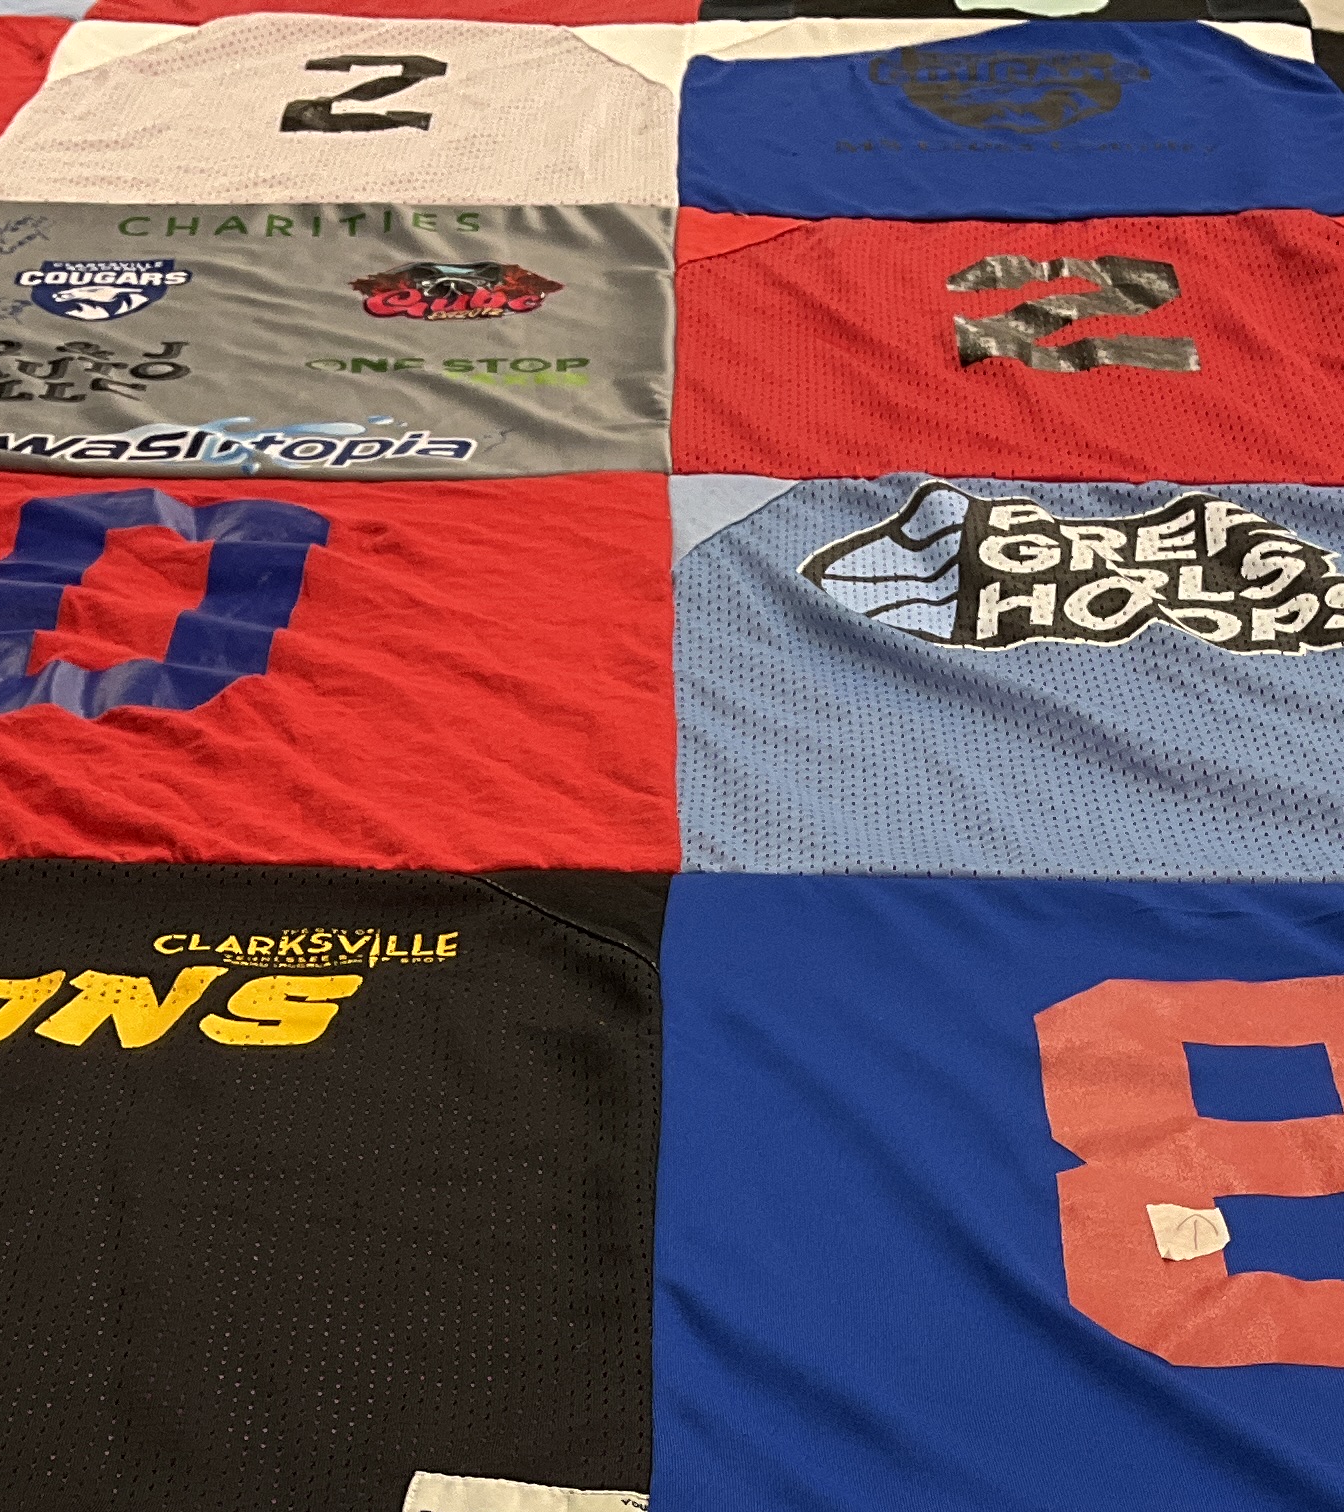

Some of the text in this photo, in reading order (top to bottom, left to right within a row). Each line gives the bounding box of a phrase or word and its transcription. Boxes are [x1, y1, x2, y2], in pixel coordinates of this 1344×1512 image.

[279, 54, 448, 133] 2
[117, 209, 481, 238] CHARITIES
[16, 268, 191, 287] COUGARS
[945, 253, 1202, 373] 2
[142, 340, 190, 360] J
[305, 357, 591, 374] ONE STOP
[153, 930, 460, 967] CLARKSVILLE
